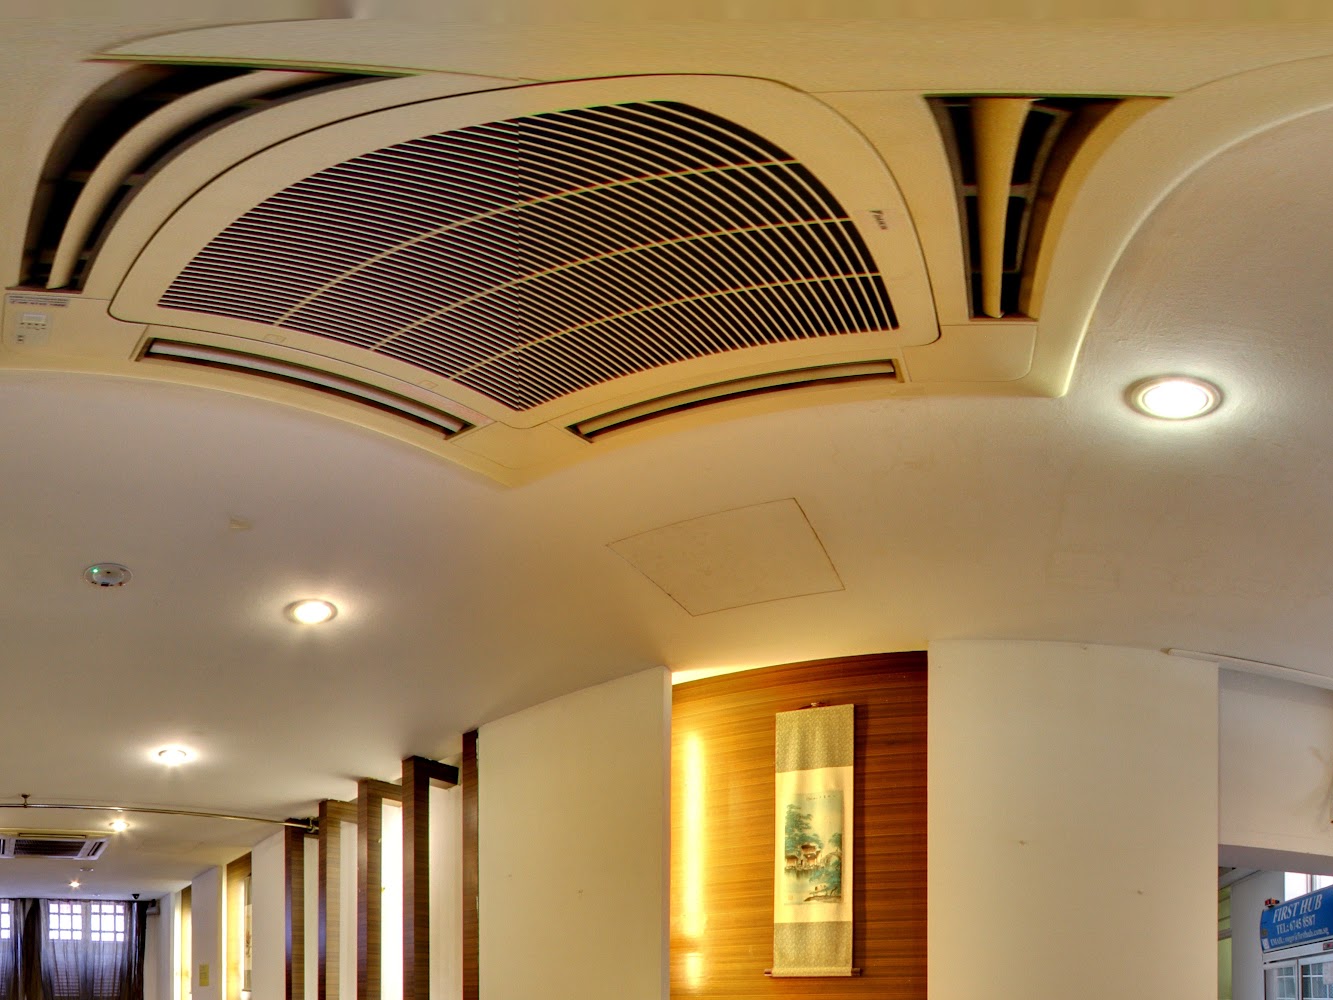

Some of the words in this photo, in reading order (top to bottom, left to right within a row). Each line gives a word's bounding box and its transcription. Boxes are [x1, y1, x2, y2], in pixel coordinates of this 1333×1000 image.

[1272, 902, 1300, 923] FIRST
[1300, 894, 1322, 914] HUB
[1276, 922, 1289, 934] TEL:
